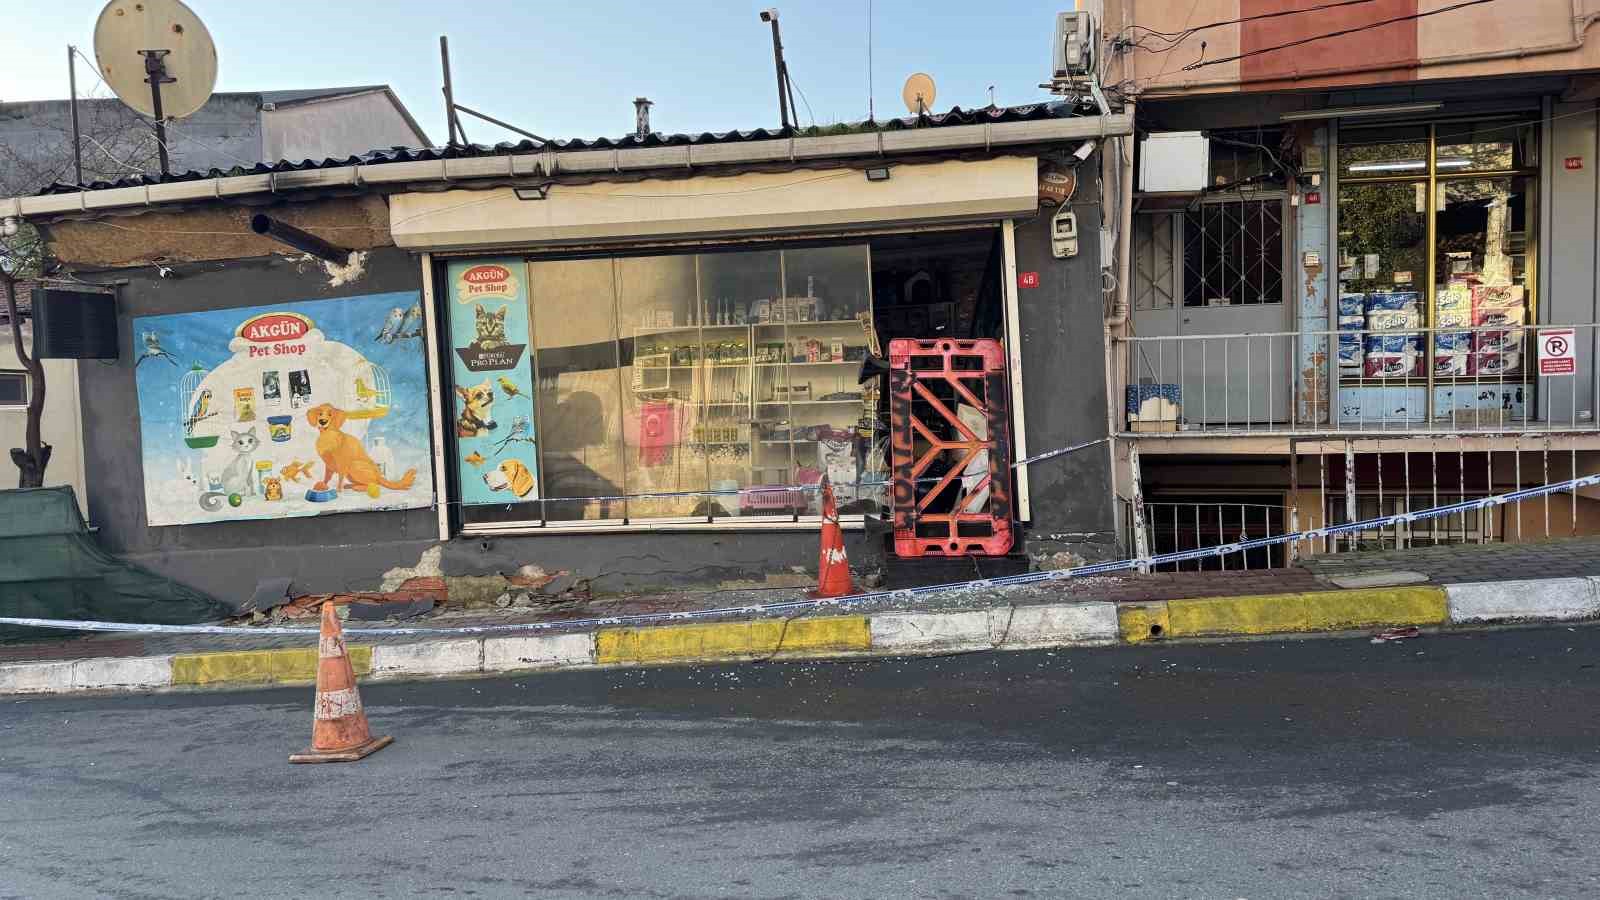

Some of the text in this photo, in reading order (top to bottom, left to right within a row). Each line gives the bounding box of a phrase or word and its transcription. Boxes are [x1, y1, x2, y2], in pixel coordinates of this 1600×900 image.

[469, 284, 508, 294] Pet Shop
[1384, 316, 1408, 329] Solo
[250, 320, 300, 339] AKGÜN
[249, 343, 306, 357] Pet Shop
[489, 358, 514, 366] PLAN
